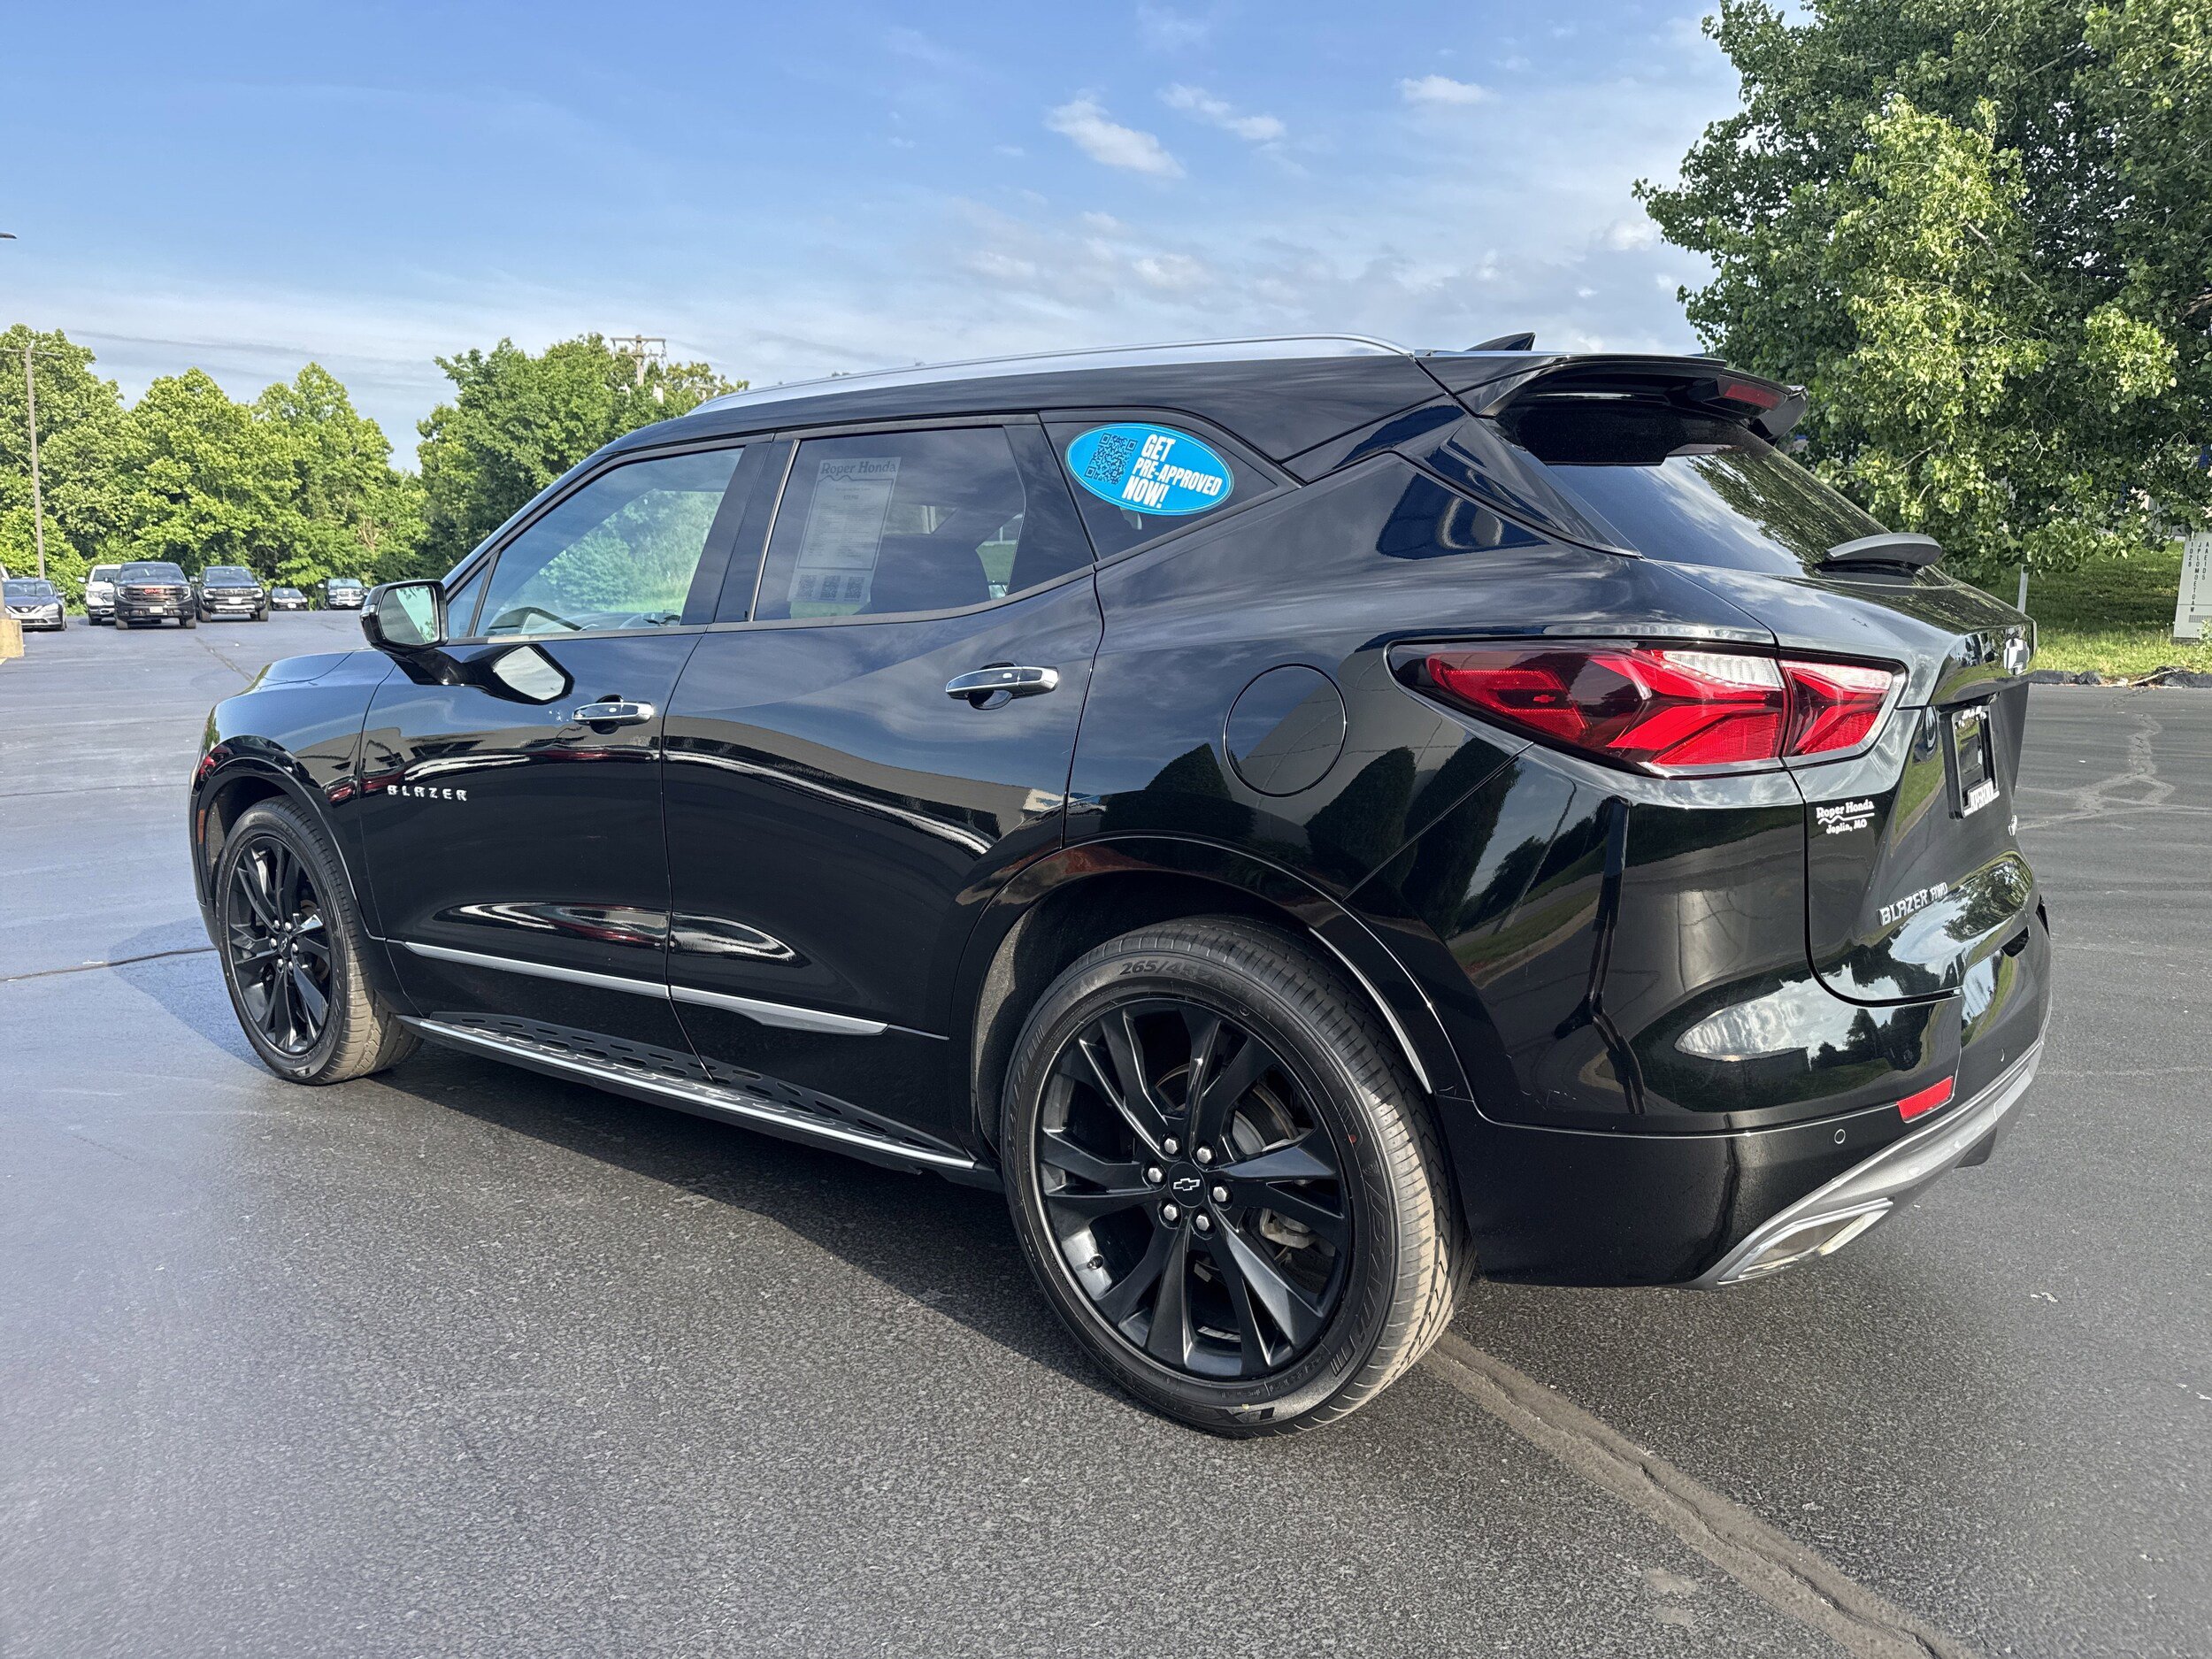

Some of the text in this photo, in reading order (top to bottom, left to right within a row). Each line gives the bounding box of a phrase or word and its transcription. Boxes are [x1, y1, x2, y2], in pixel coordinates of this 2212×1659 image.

[1141, 434, 1177, 463] GET
[820, 460, 897, 476] Roper Honda
[1132, 457, 1224, 496] PRE-APPROVED
[1121, 474, 1171, 510] NOW!
[387, 784, 467, 802] BLAZER
[1816, 799, 1875, 818] Roper Honda
[1825, 818, 1868, 834] Joplin, MO
[1878, 888, 1928, 926] BLAZER
